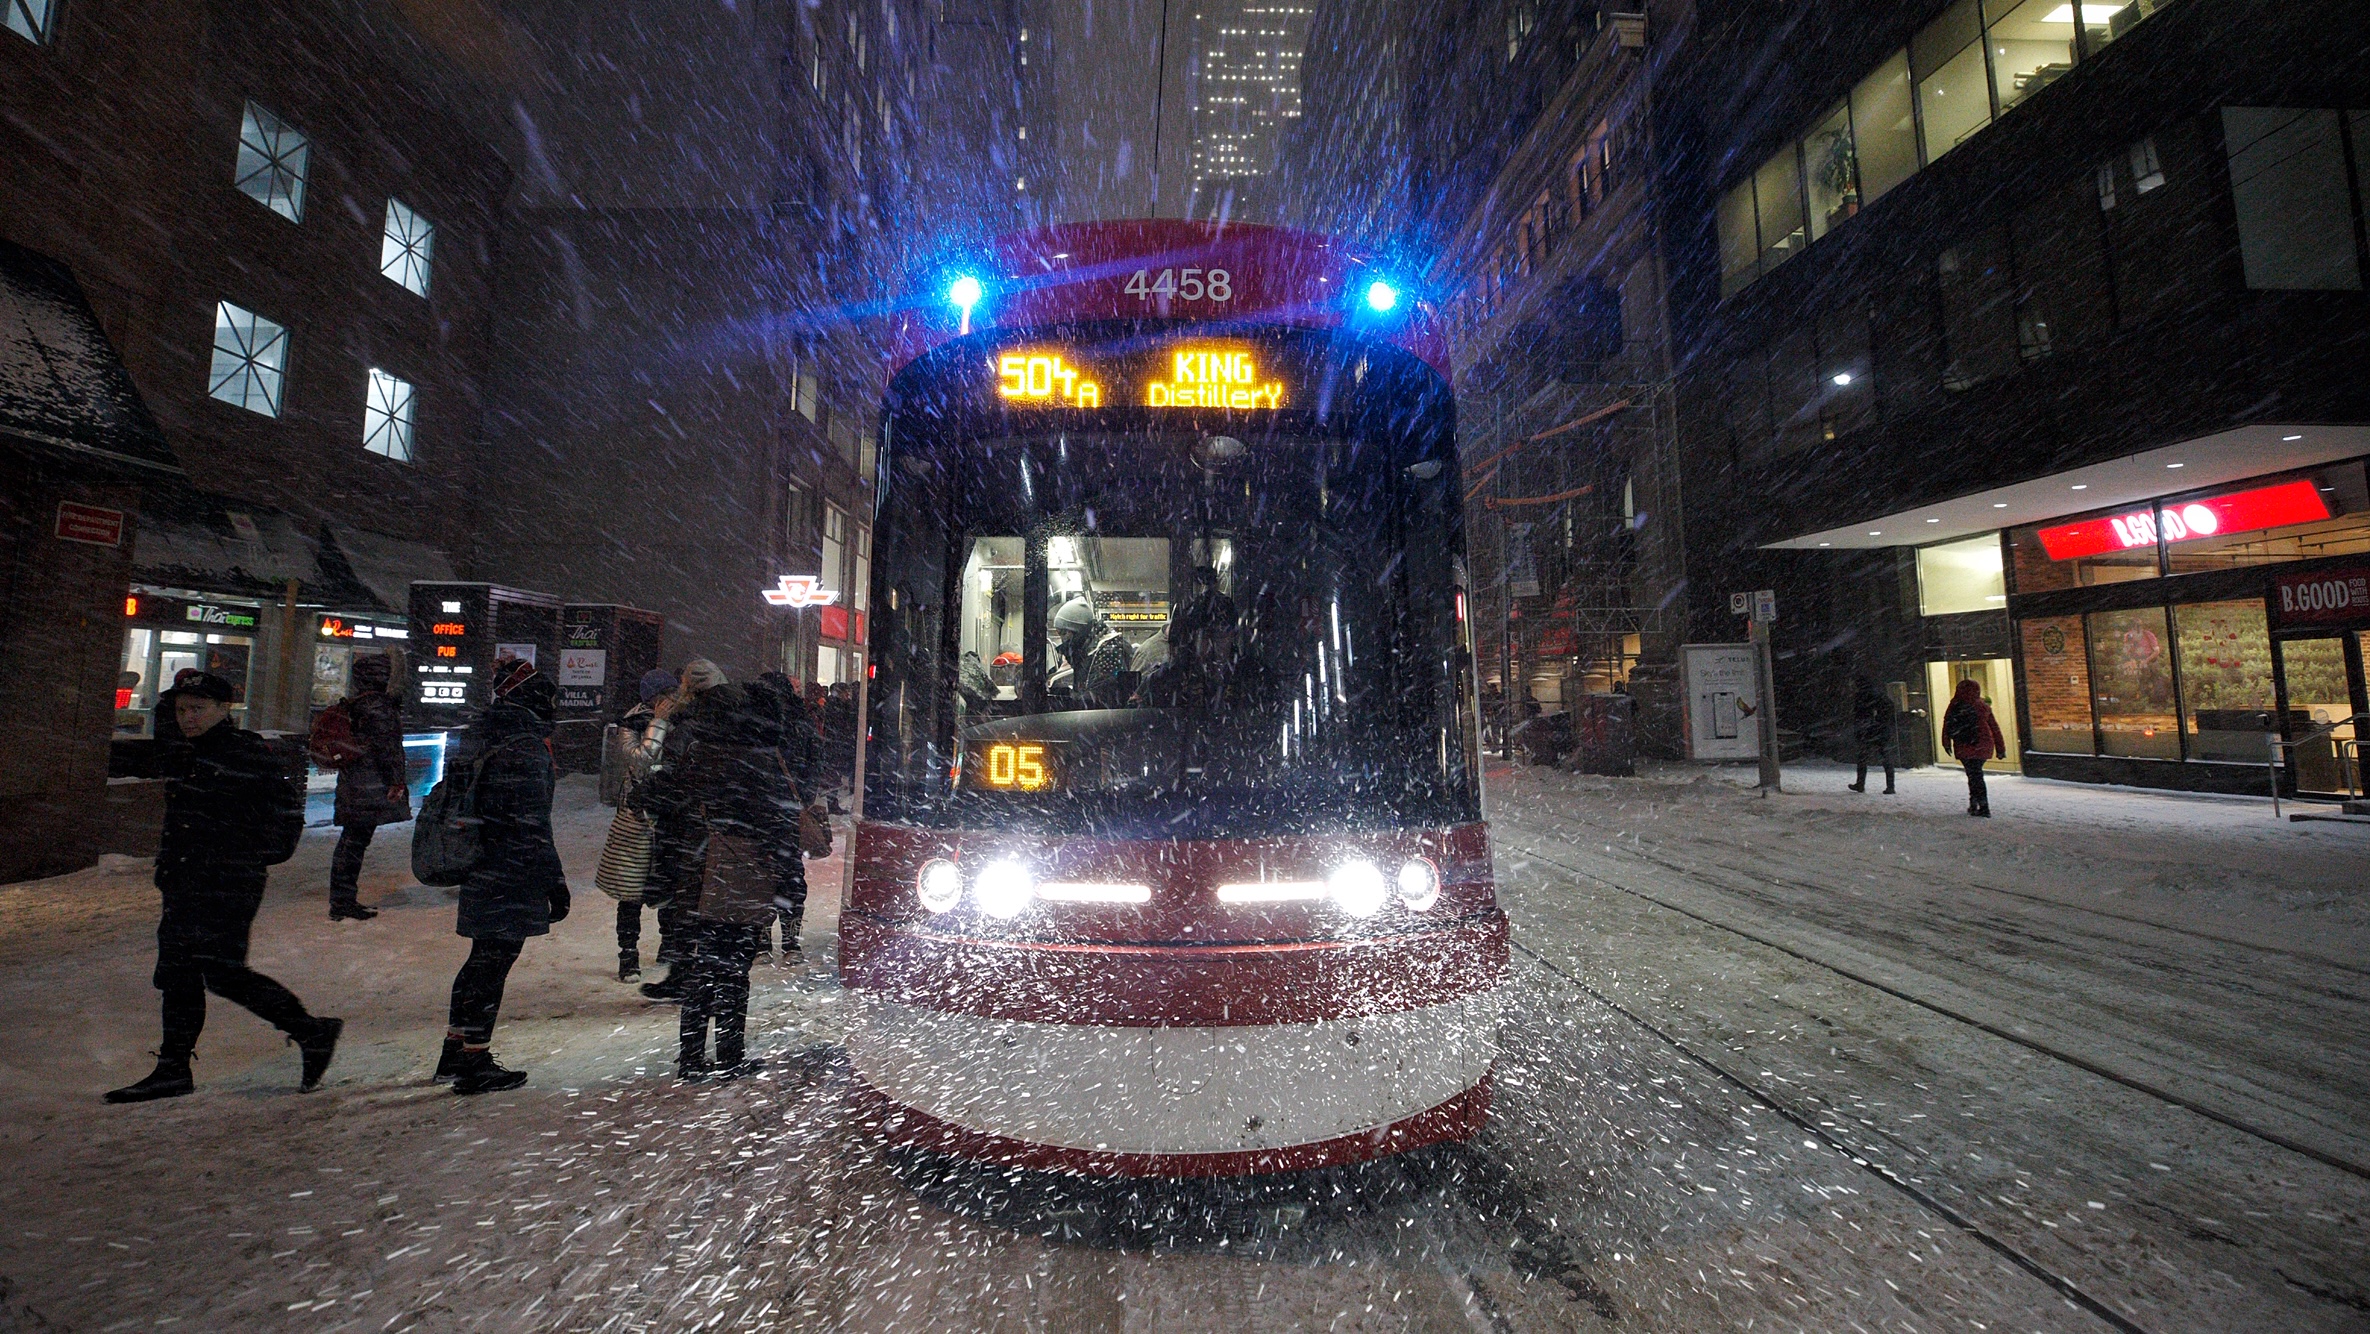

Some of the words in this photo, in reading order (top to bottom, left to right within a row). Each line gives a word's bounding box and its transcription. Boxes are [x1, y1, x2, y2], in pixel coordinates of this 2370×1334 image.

[1124, 268, 1232, 302] 4458
[1175, 352, 1253, 384] KING
[1148, 383, 1282, 409] Distillery
[78, 515, 120, 527] DEPARTMENT
[2111, 509, 2187, 547] B.GOOD
[2349, 578, 2366, 588] FOOD
[2281, 580, 2350, 612] B.GOOD
[2350, 586, 2368, 597] WITH
[2351, 595, 2370, 605] ROOTS
[442, 602, 460, 612] THE
[1126, 613, 1139, 621] right
[433, 622, 464, 635] OFFICE
[438, 646, 456, 657] PUB
[564, 691, 588, 700] VILLA
[559, 699, 594, 708] MADINA
[989, 744, 1045, 788] 05
